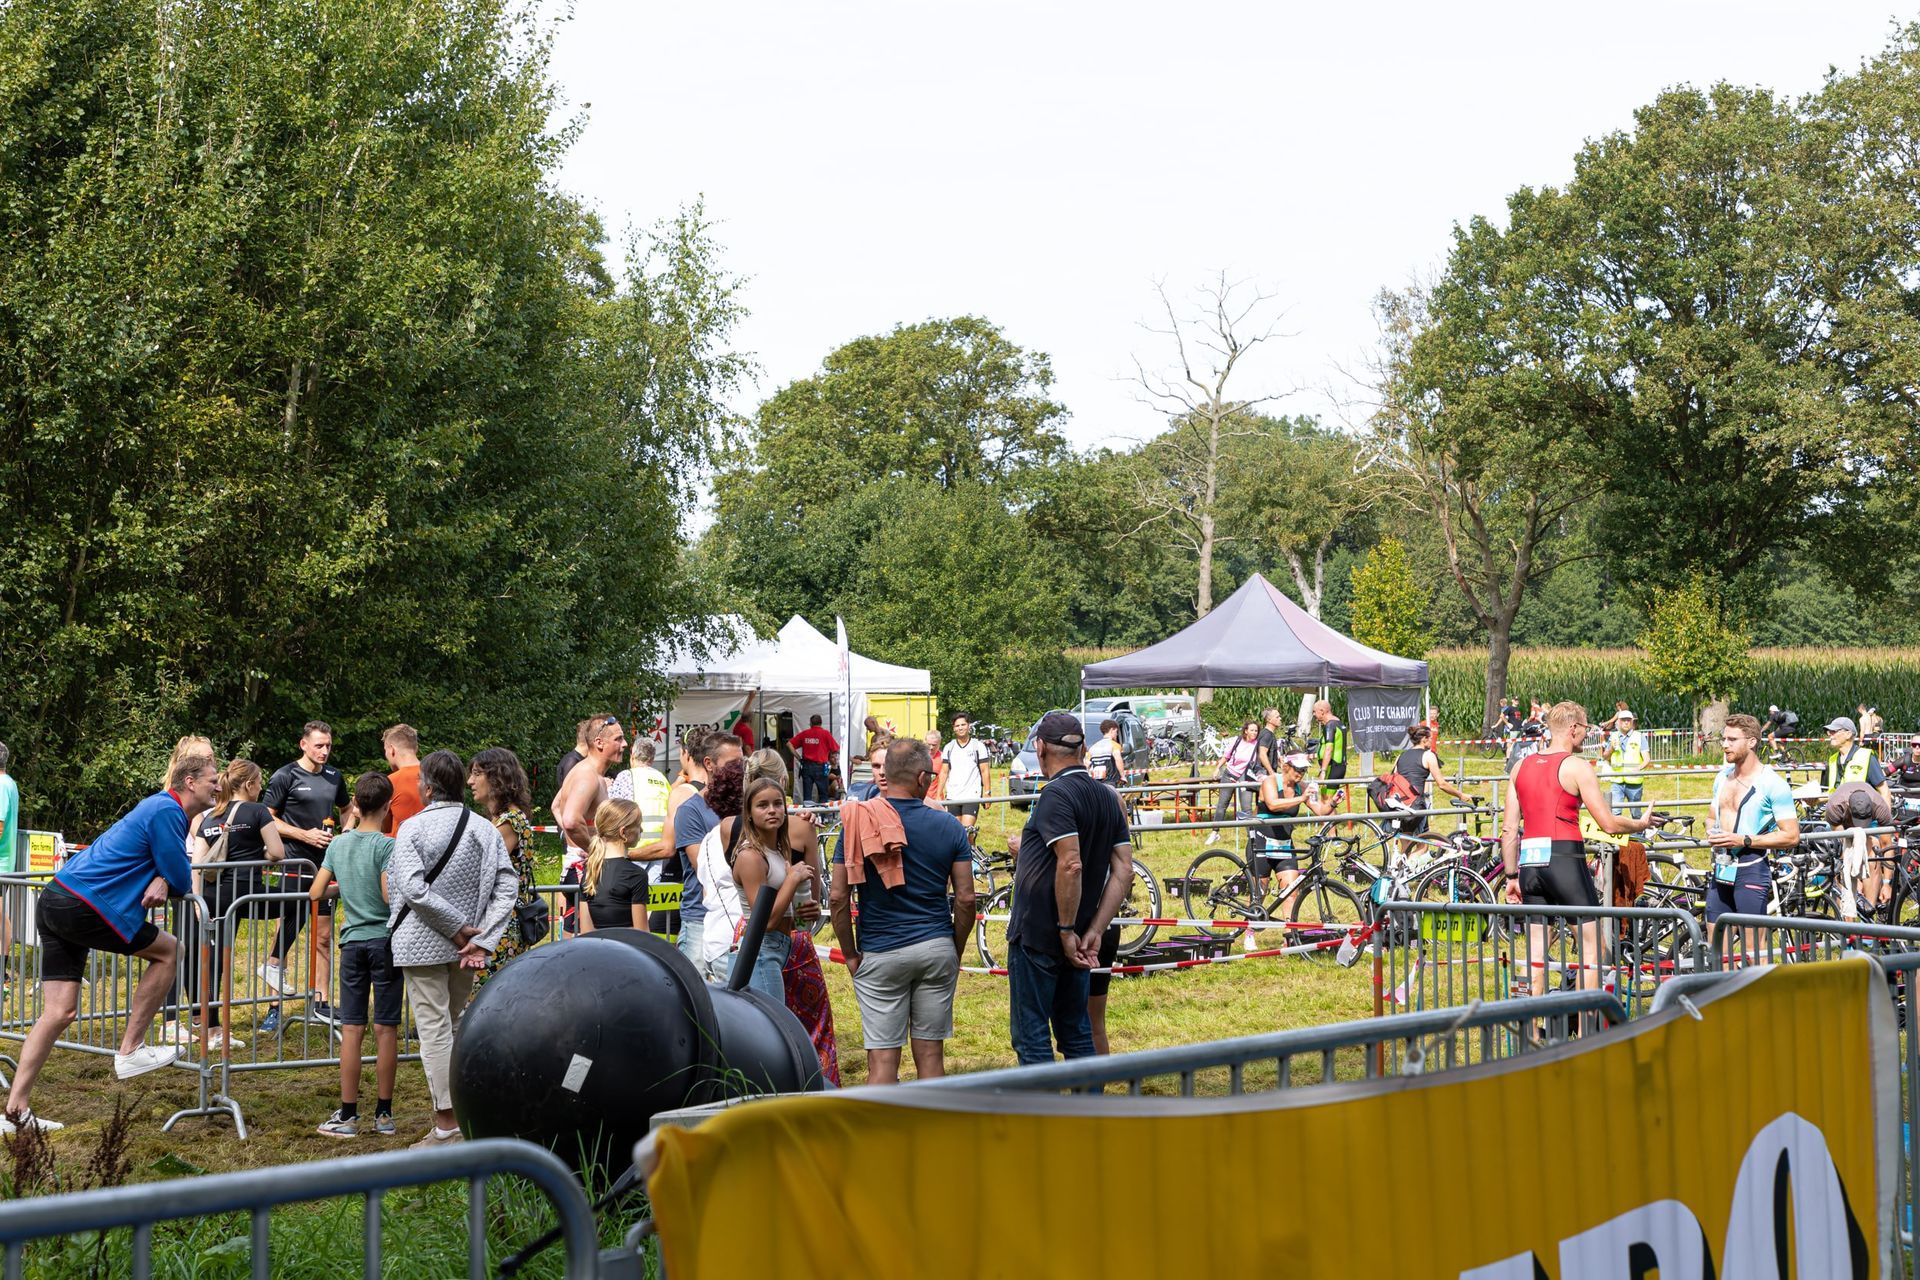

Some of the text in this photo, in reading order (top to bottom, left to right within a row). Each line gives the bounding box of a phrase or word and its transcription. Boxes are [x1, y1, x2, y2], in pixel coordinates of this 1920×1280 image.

[1353, 706, 1371, 721] CLUB
[1386, 705, 1416, 720] CHARIOT
[1431, 919, 1459, 933] opn
